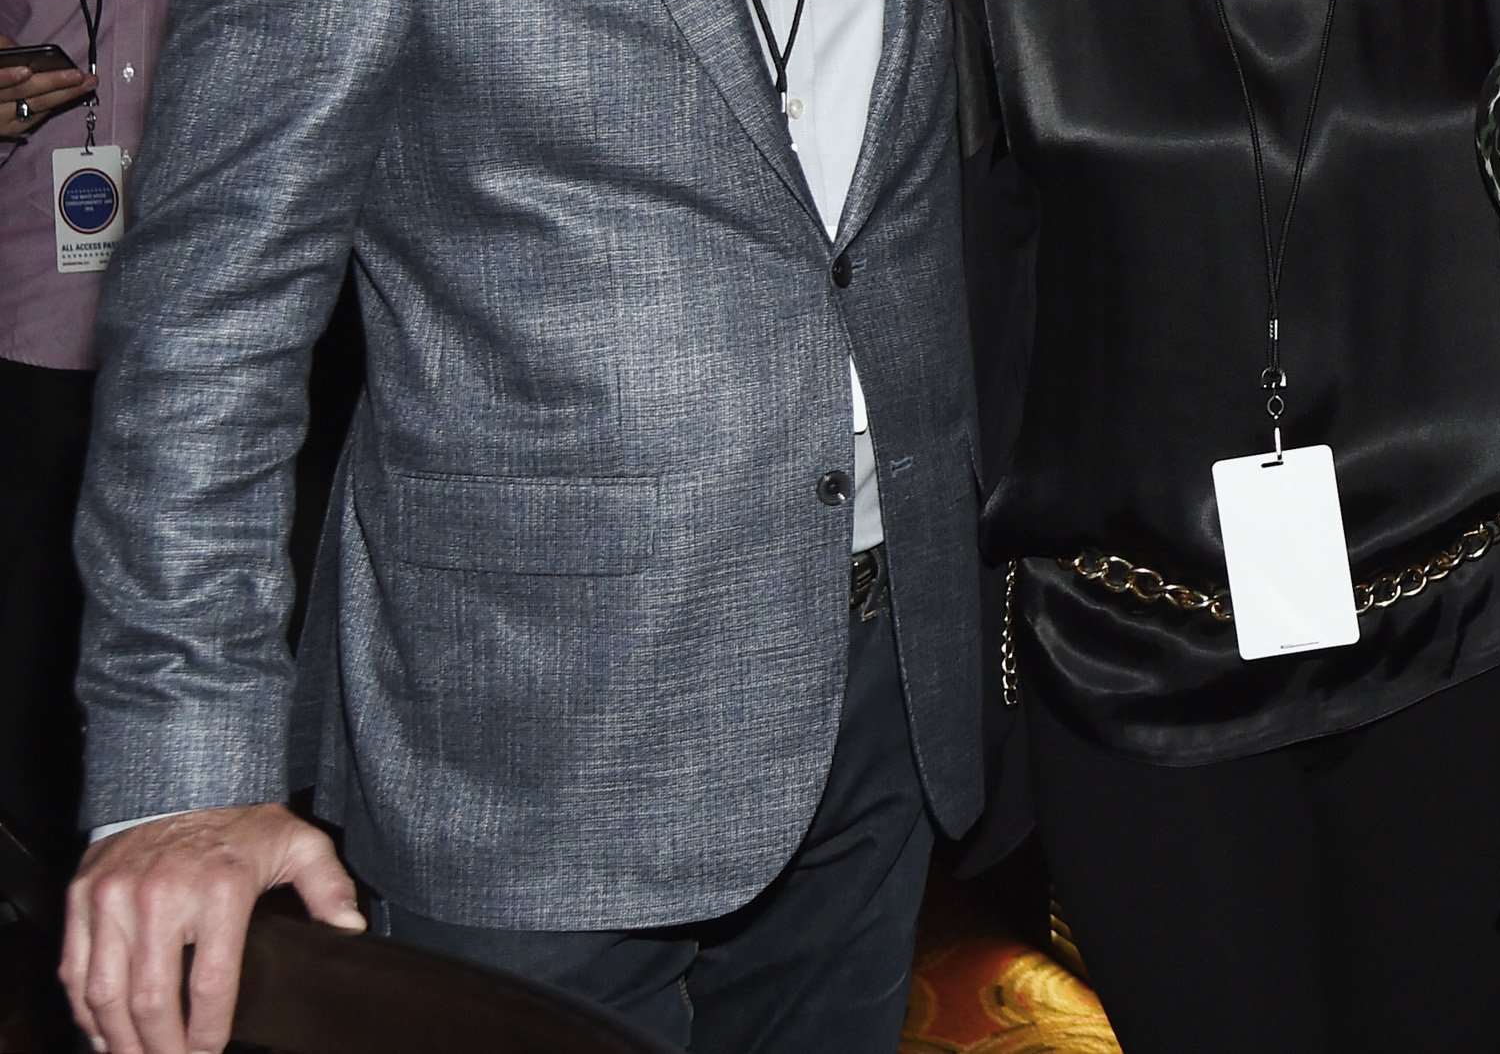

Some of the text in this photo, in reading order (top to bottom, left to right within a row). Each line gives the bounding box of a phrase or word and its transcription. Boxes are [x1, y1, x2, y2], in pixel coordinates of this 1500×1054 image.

[62, 241, 116, 251] ALL ACCESS PAS
